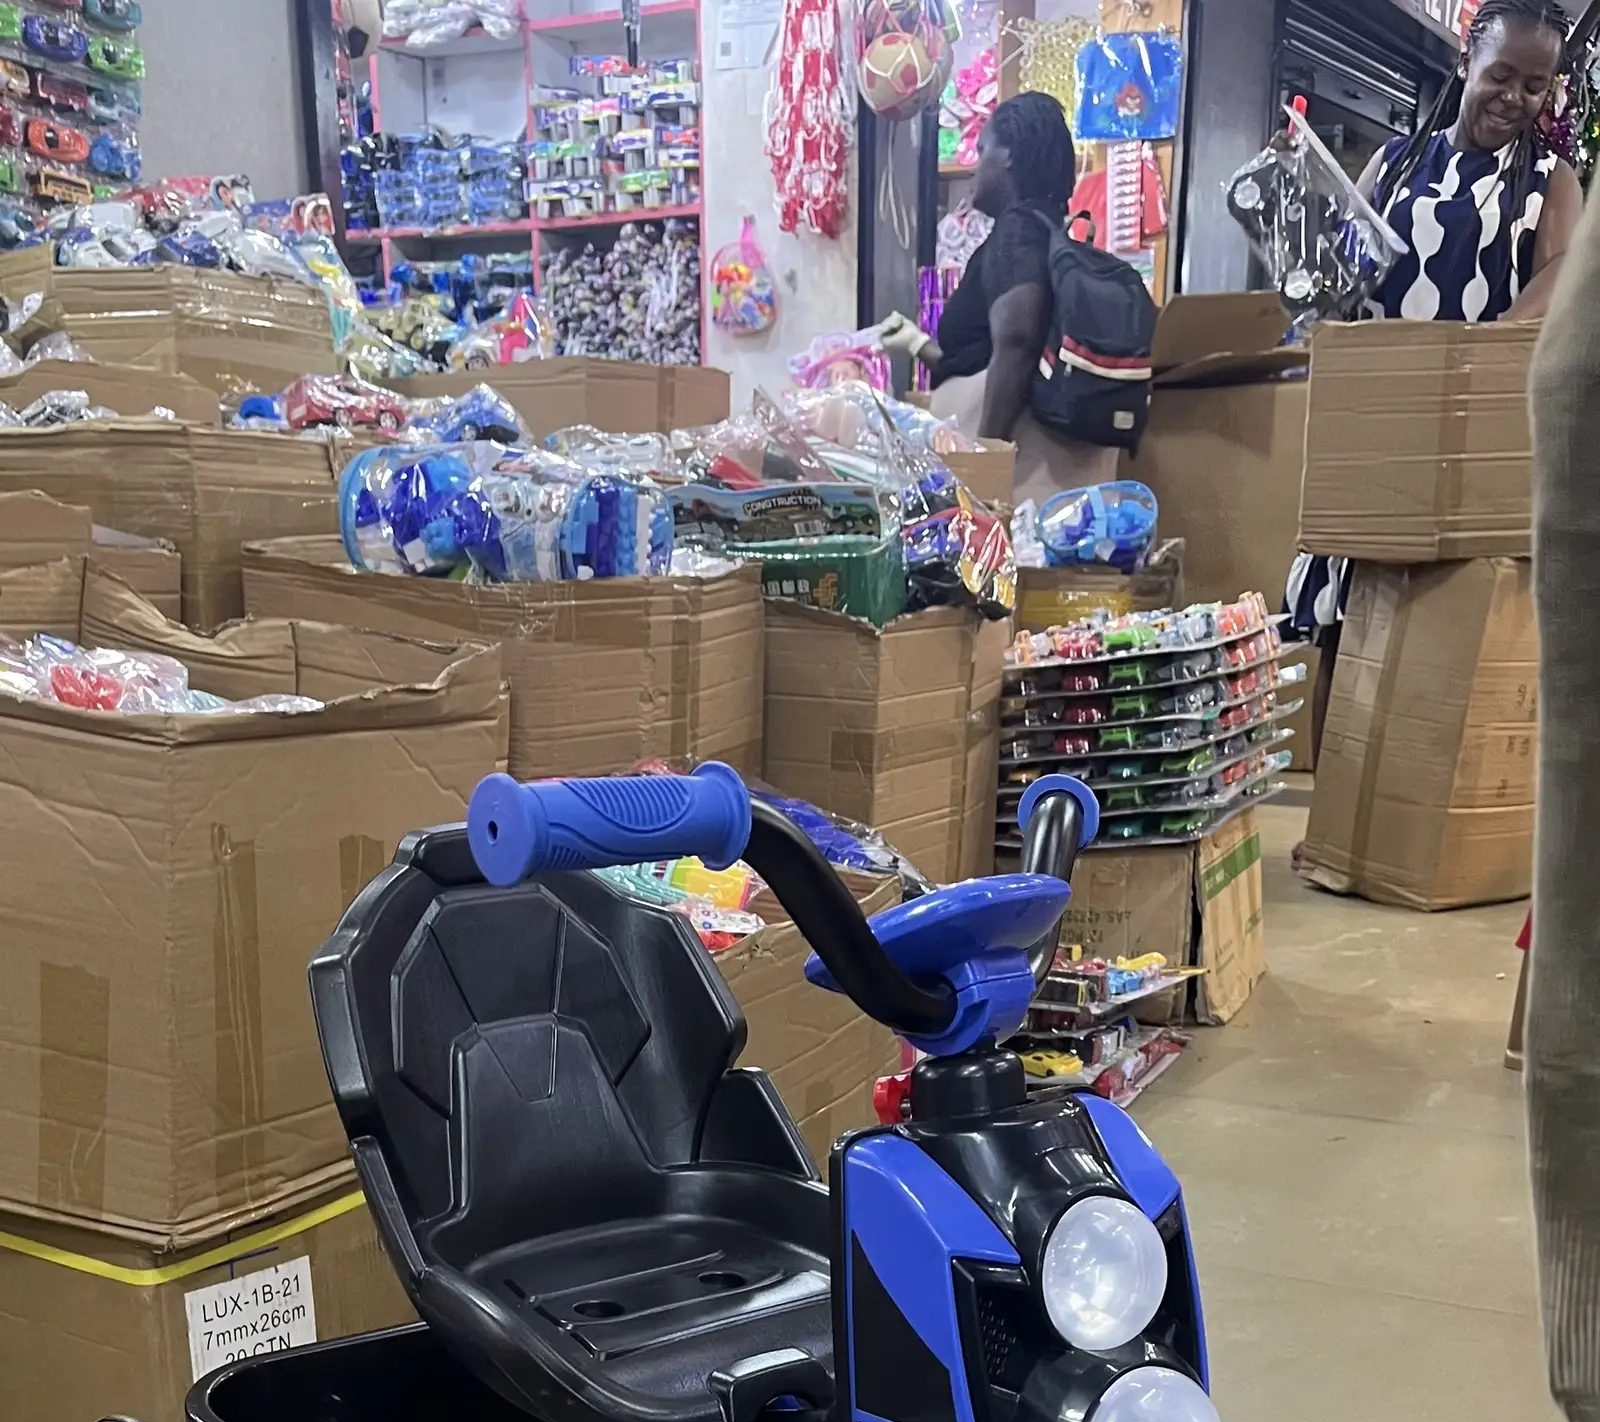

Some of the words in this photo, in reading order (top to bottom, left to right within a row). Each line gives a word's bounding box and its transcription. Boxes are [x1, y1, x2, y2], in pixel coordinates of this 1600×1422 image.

[202, 1274, 300, 1323] LUX-1B-21
[203, 1304, 306, 1351] 7mmx26cm
[253, 1332, 291, 1355] CTN
